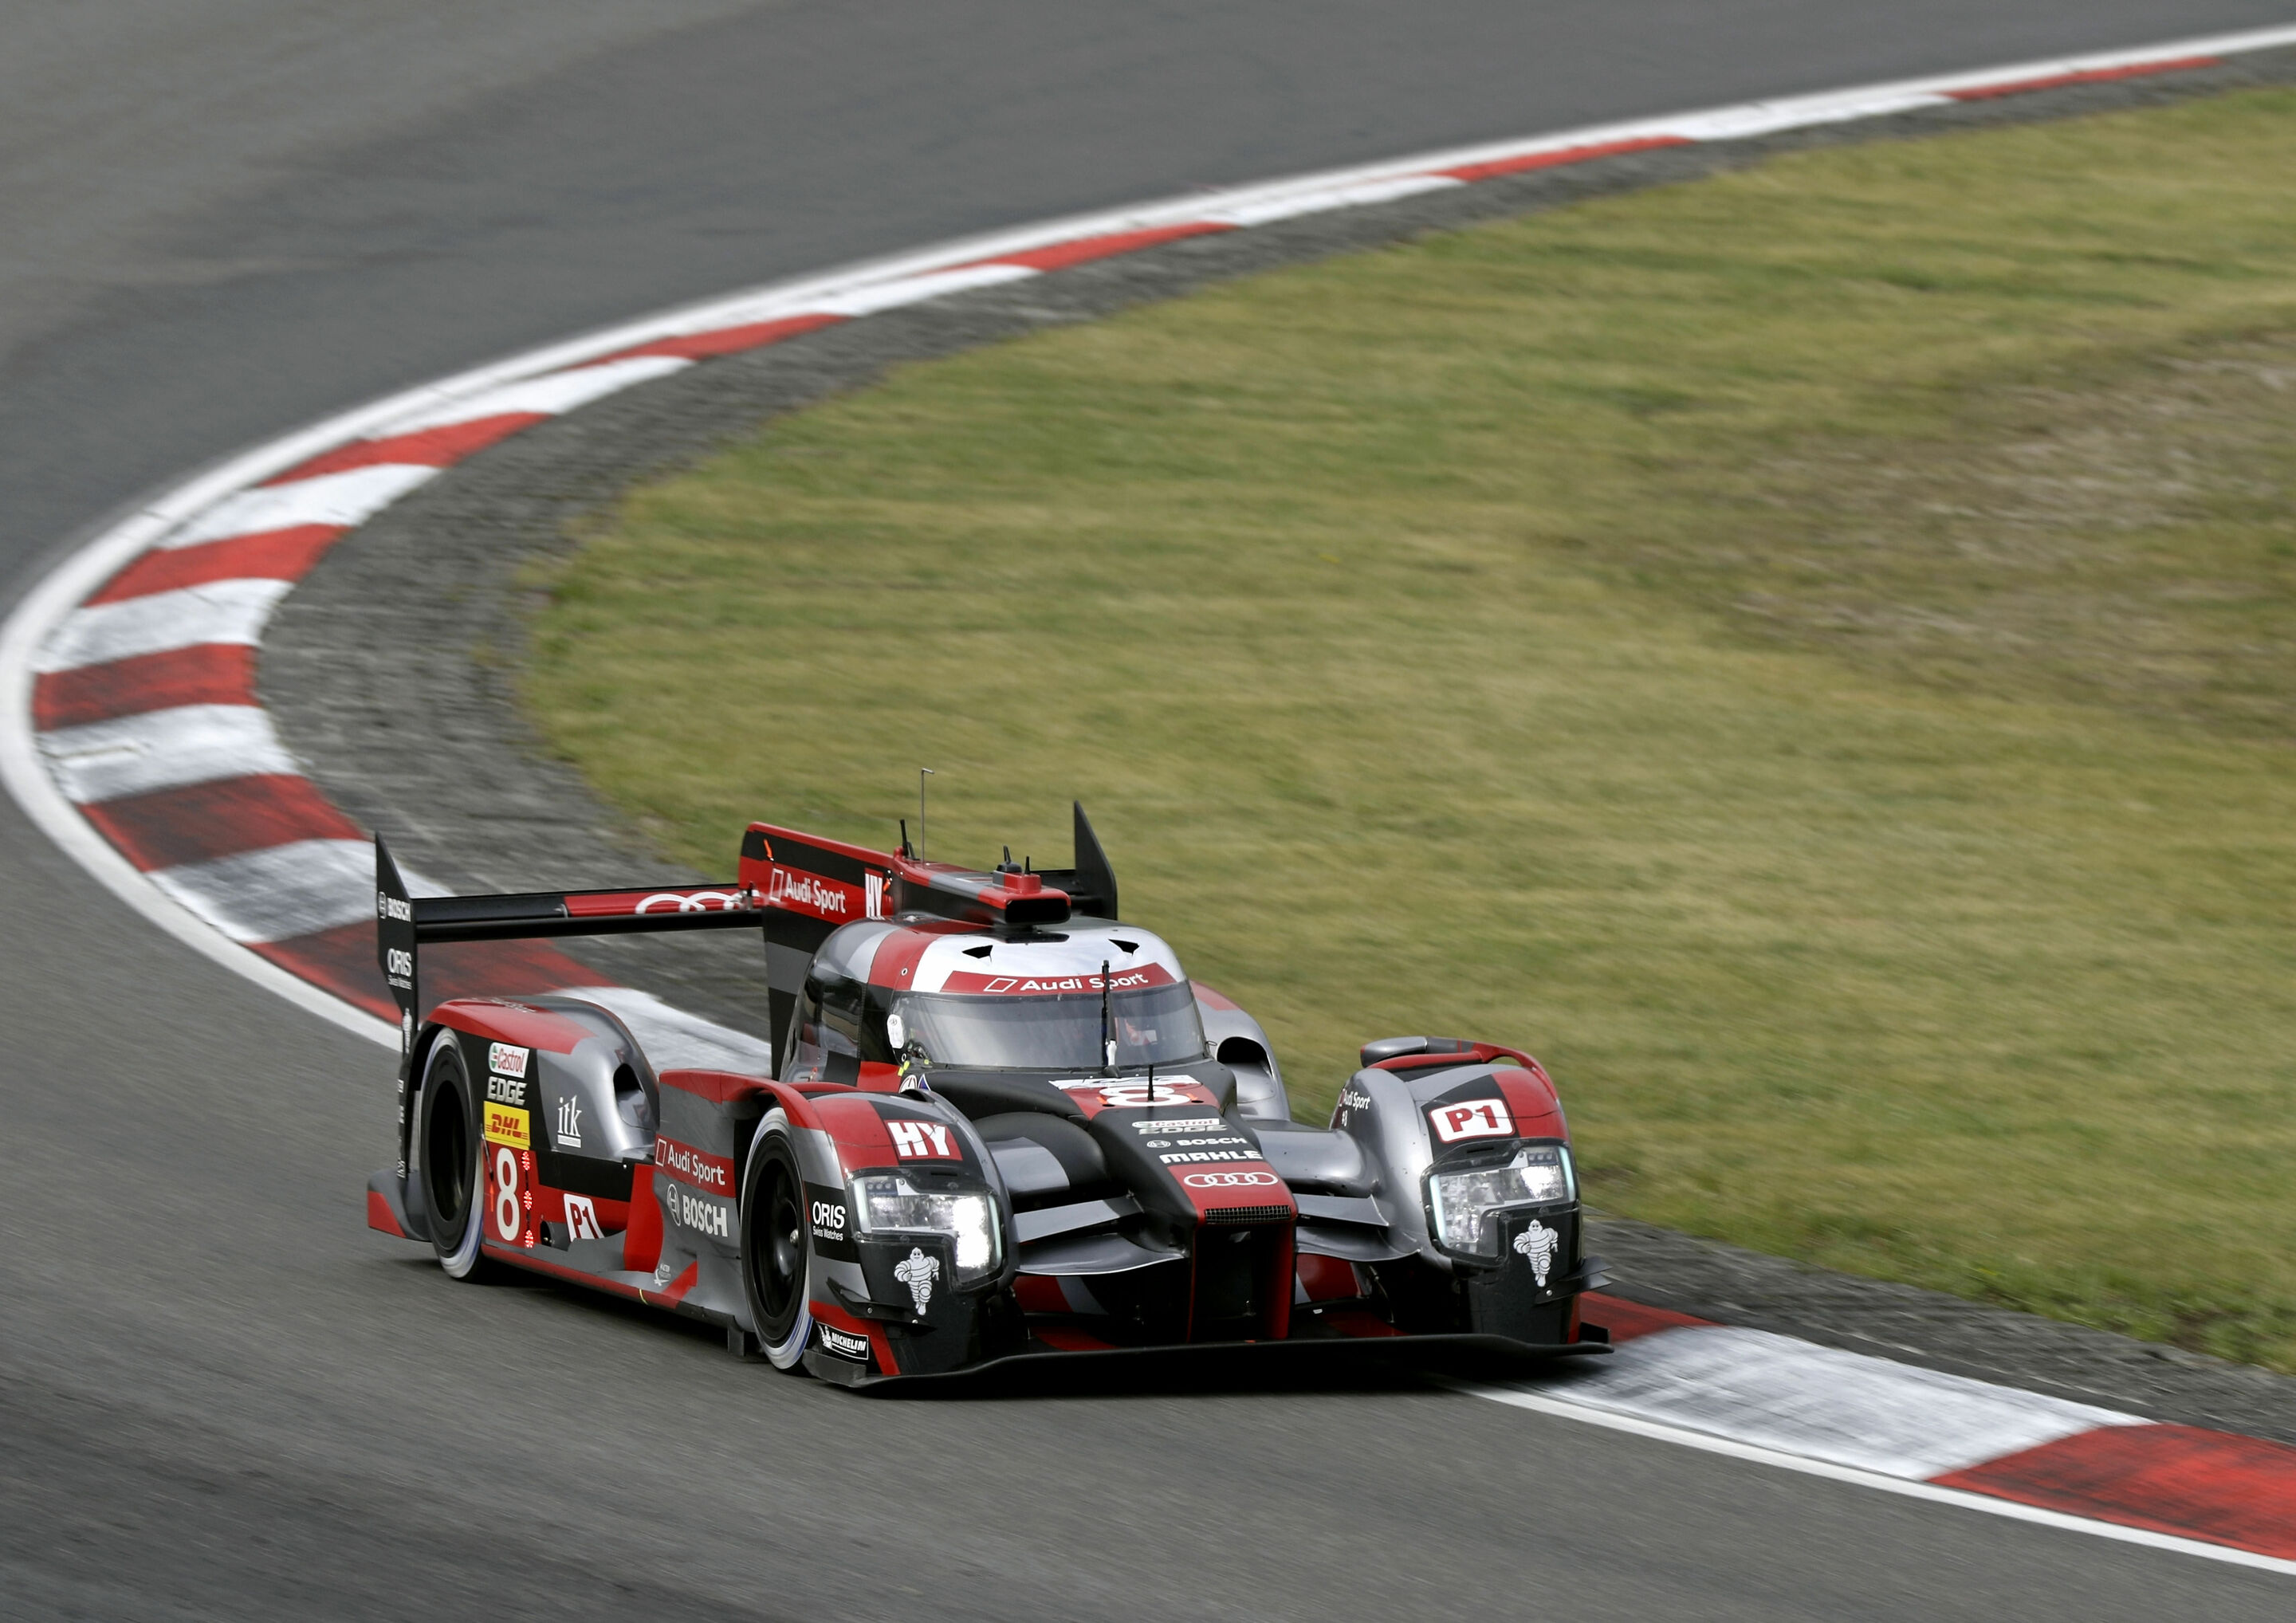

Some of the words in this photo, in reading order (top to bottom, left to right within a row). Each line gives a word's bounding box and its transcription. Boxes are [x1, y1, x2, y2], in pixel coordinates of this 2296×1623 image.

[785, 874, 811, 902] Audi
[814, 881, 847, 914] Sport
[387, 897, 411, 922] BOSCH
[387, 948, 412, 977] ORIS
[1020, 978, 1083, 992] Audi
[1091, 973, 1149, 992] Sport
[497, 1047, 525, 1073] Castrol
[487, 1076, 528, 1106] EDGE
[1099, 1086, 1191, 1107] 8
[1352, 1091, 1371, 1112] Sport
[489, 1113, 525, 1139] DHL
[557, 1094, 582, 1138] itk
[1138, 1124, 1228, 1135] EDGE
[1445, 1105, 1500, 1132] P1
[887, 1122, 951, 1157] HY
[1176, 1137, 1248, 1146] BOSCH
[668, 1143, 690, 1173] Audi
[692, 1153, 726, 1186] Sport
[1158, 1149, 1264, 1164] MAHLE
[496, 1147, 520, 1241] 8
[569, 1202, 600, 1239] P1
[682, 1195, 729, 1237] BOSCH
[812, 1201, 846, 1229] ORIS
[832, 1332, 867, 1352] MICHELIN
